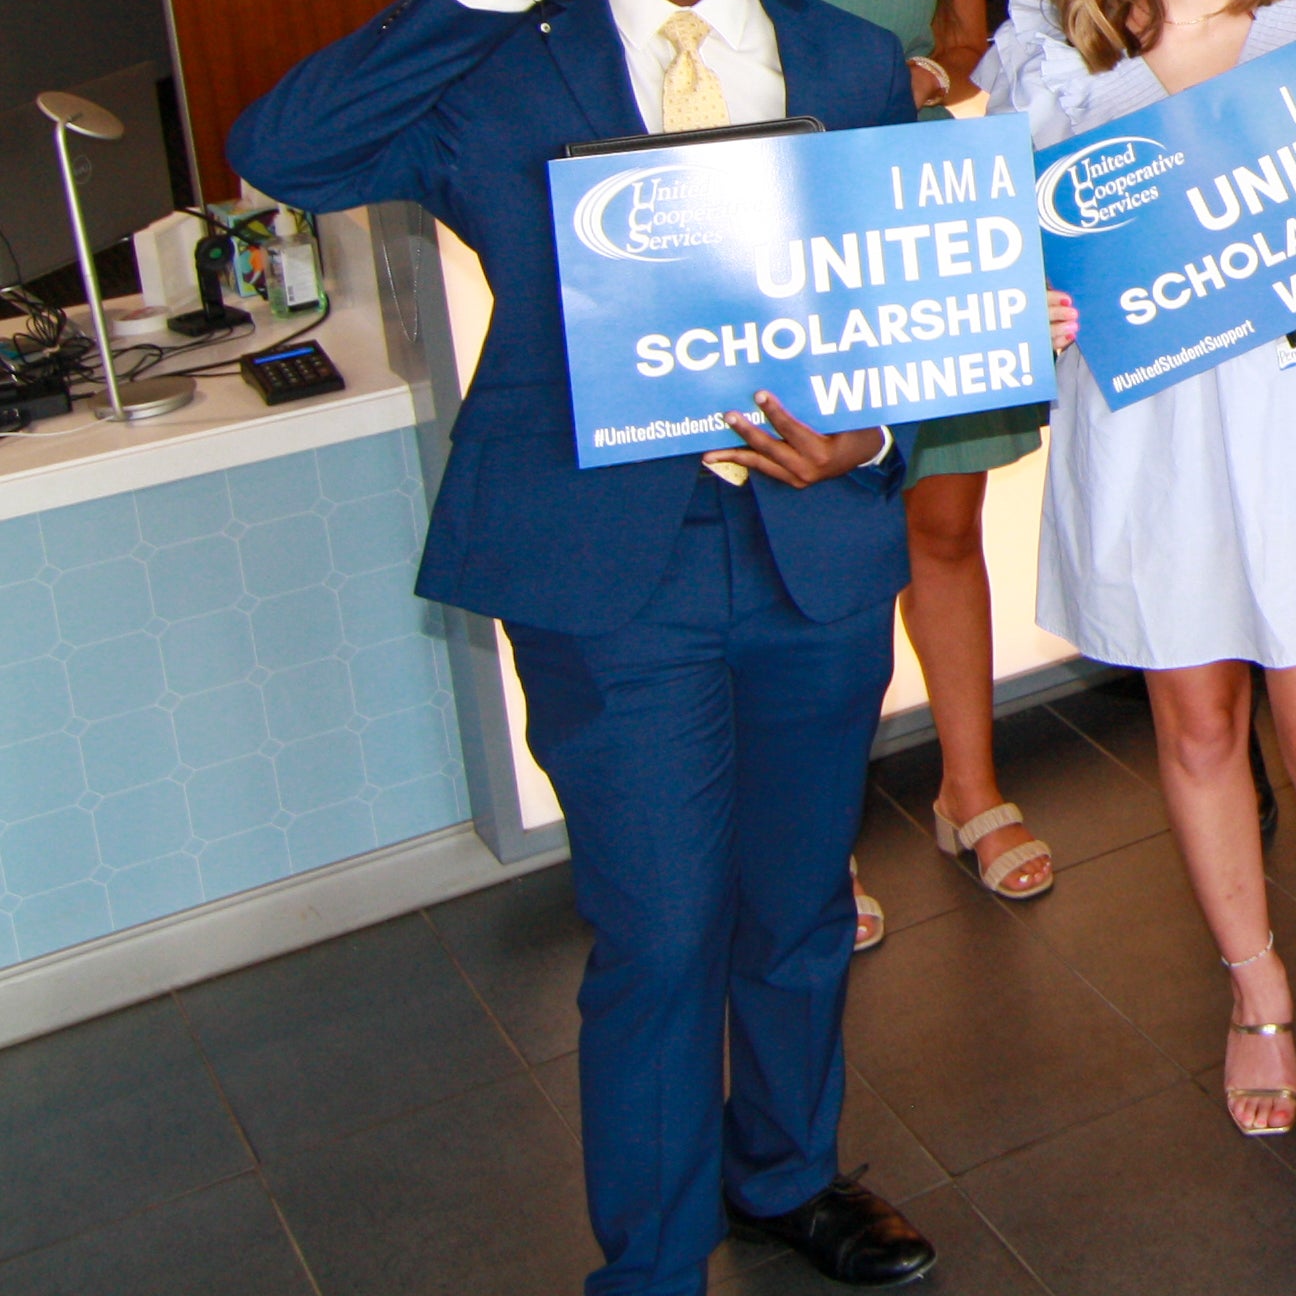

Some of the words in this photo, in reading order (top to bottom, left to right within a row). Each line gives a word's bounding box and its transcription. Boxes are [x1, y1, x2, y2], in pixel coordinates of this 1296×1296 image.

[891, 166, 903, 210] I
[918, 158, 978, 206] AM
[991, 156, 1016, 198] A
[1067, 143, 1137, 189] United
[1074, 152, 1185, 209] Cooperative
[1081, 185, 1159, 227] Services
[626, 229, 723, 253] Services
[755, 216, 1023, 300] UNITED
[636, 289, 1027, 378] SCHOLARSHIP
[1113, 320, 1255, 394] #UnitedStudentSupport
[810, 342, 1034, 416] WINNER!
